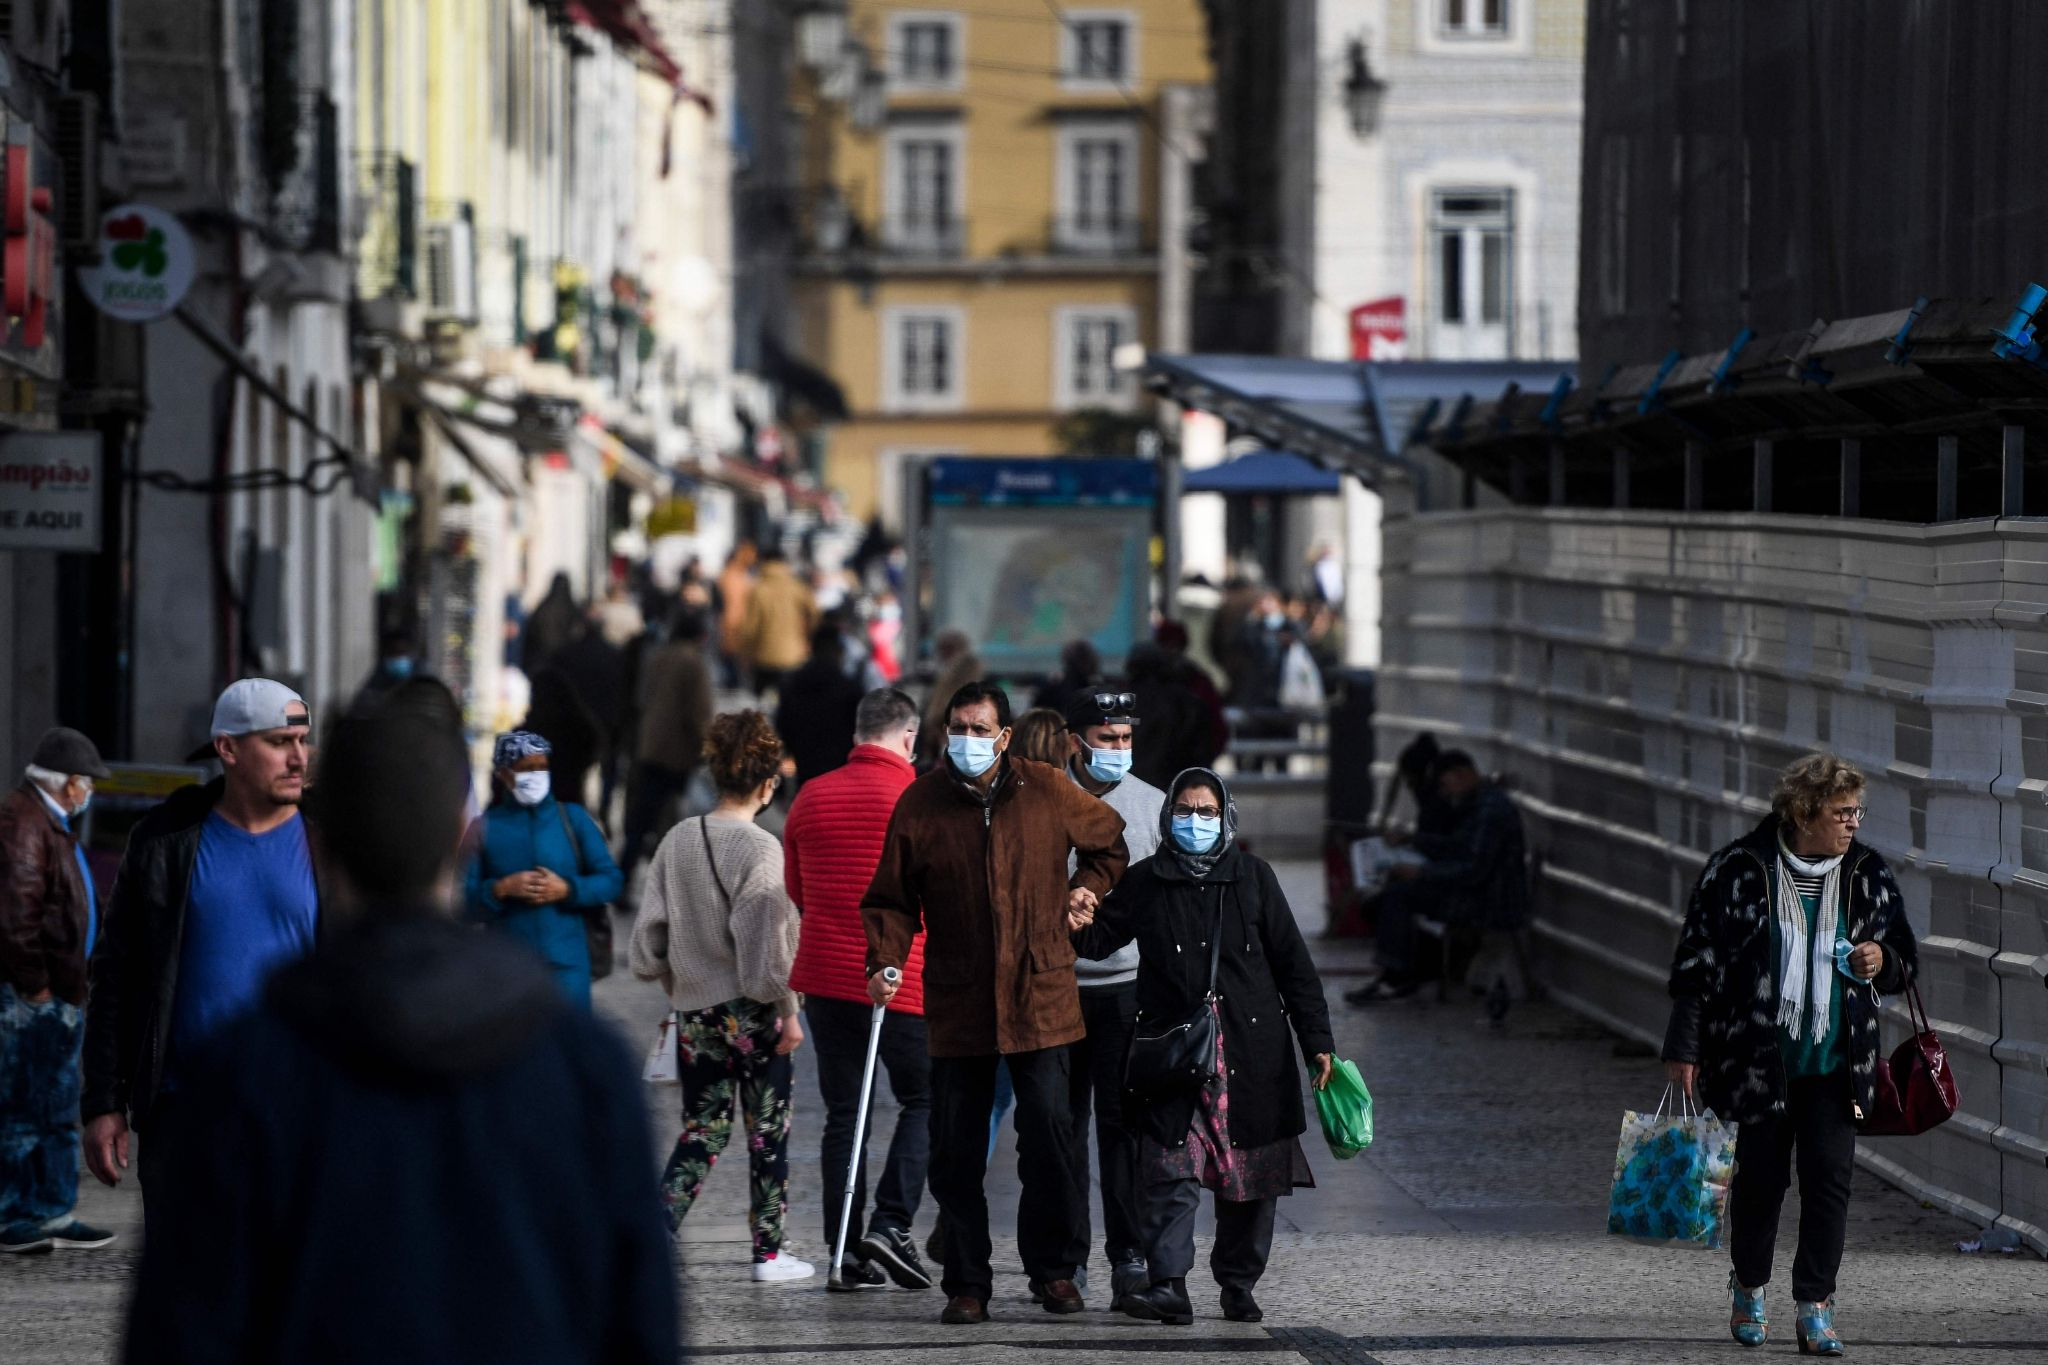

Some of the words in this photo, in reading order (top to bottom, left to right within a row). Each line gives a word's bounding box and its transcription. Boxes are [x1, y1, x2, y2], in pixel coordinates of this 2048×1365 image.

[0, 458, 92, 491] mpião
[0, 510, 17, 530] E
[23, 510, 83, 530] AQUI
